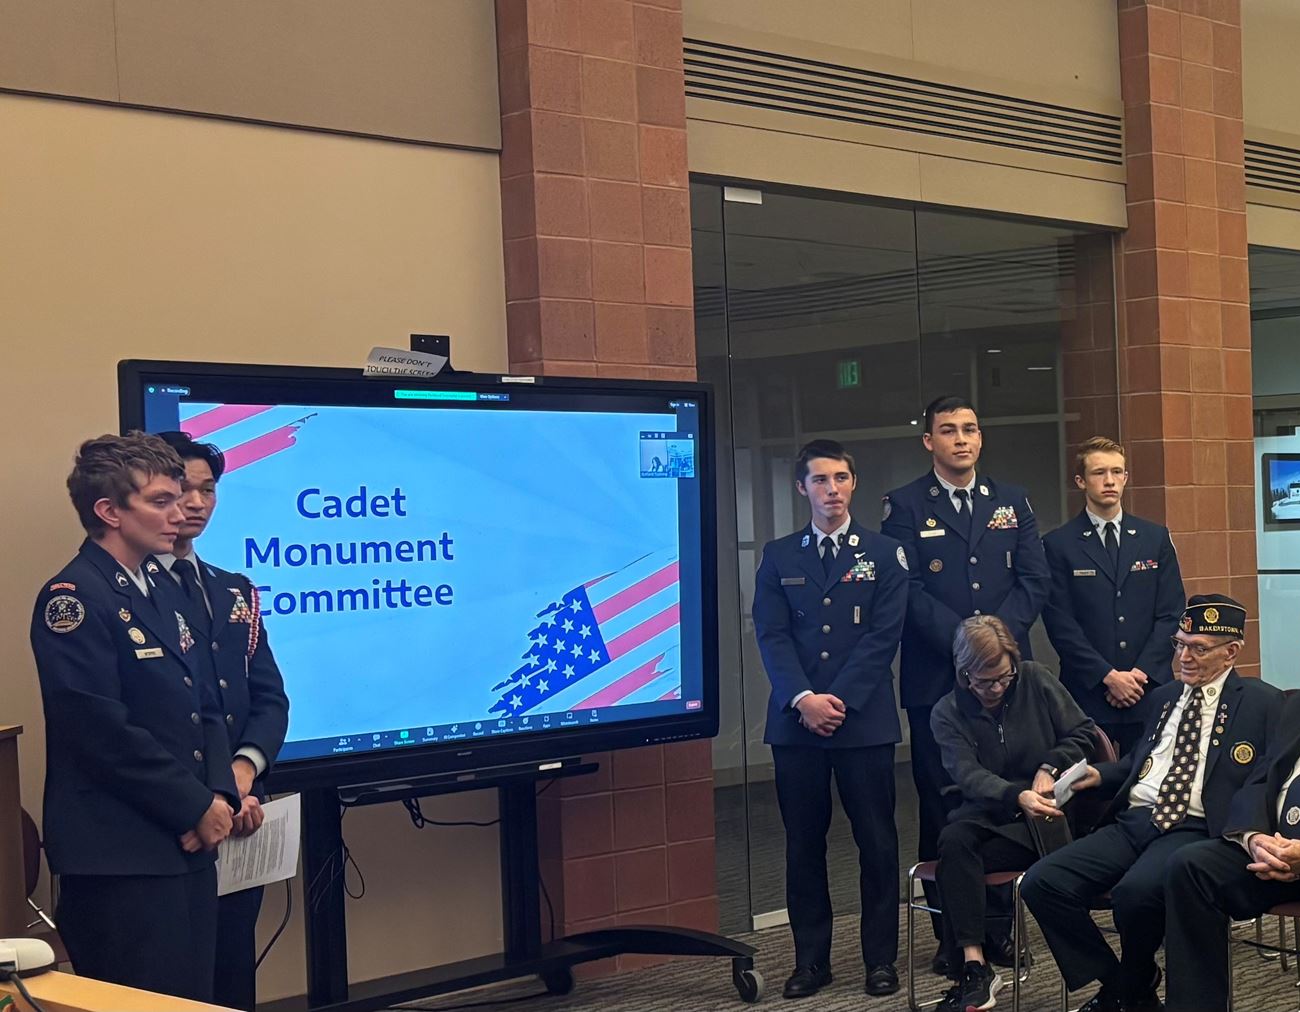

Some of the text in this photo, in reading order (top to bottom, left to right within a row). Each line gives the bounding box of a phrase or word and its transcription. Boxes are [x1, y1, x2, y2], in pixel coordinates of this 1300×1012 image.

[379, 355, 432, 367] PLEASE DON'T
[296, 486, 407, 519] Cadet
[245, 532, 454, 569] Monument
